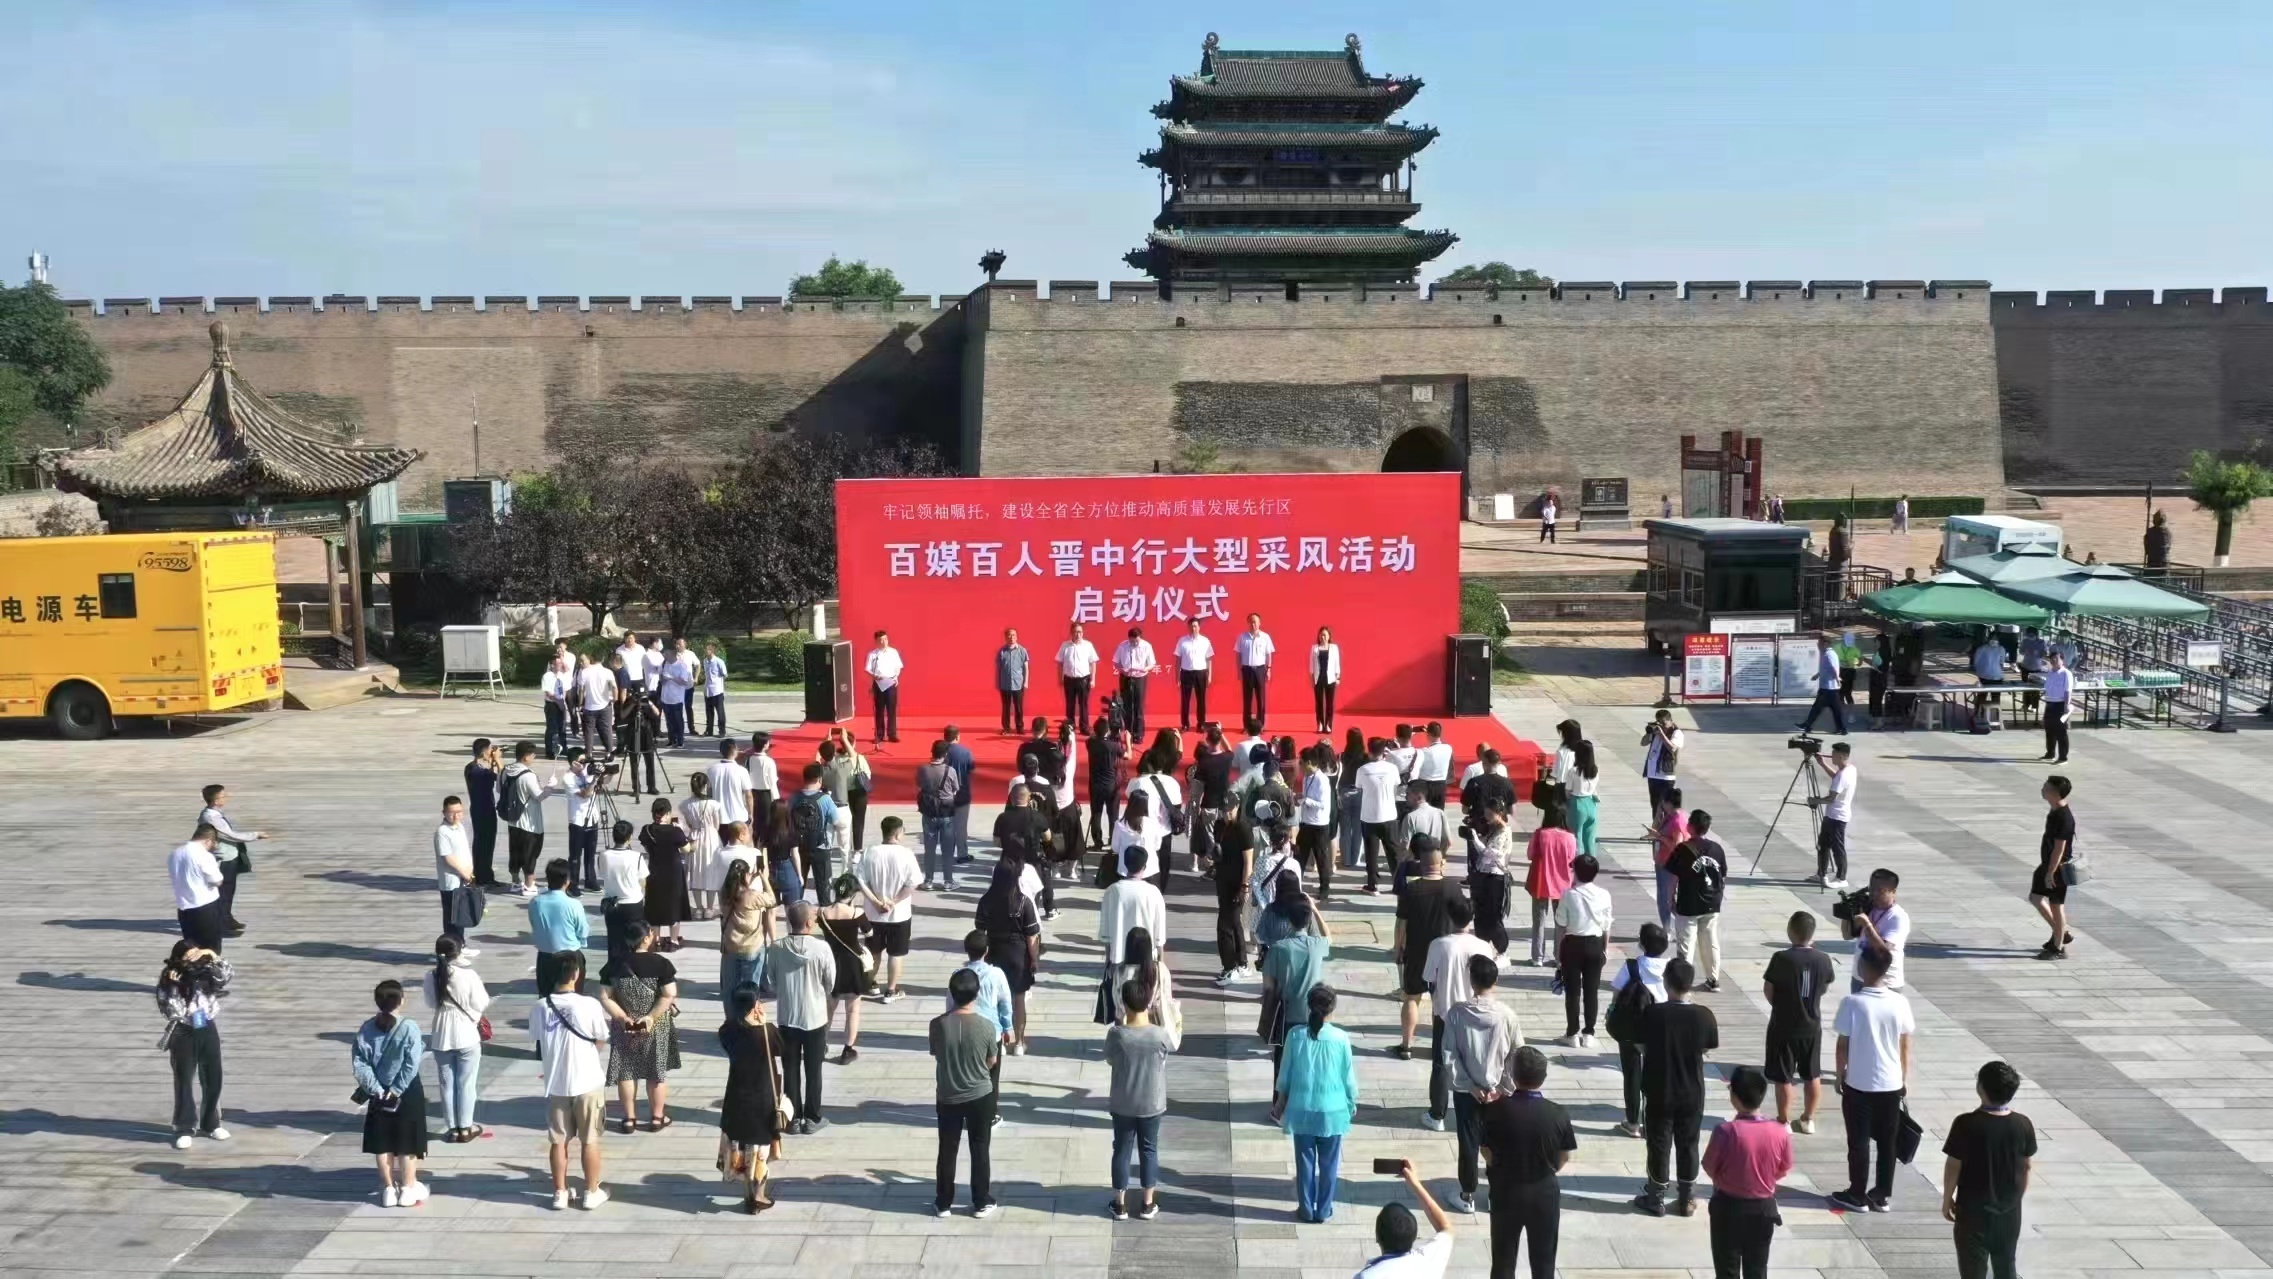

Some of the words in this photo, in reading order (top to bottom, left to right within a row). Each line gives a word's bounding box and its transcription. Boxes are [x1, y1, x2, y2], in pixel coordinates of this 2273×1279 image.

[144, 557, 189, 569] 95598
[884, 535, 1416, 577] 百媒百人晋中行大型采风活动
[1, 594, 100, 623] 电源车
[1070, 584, 1230, 623] 启动仪式
